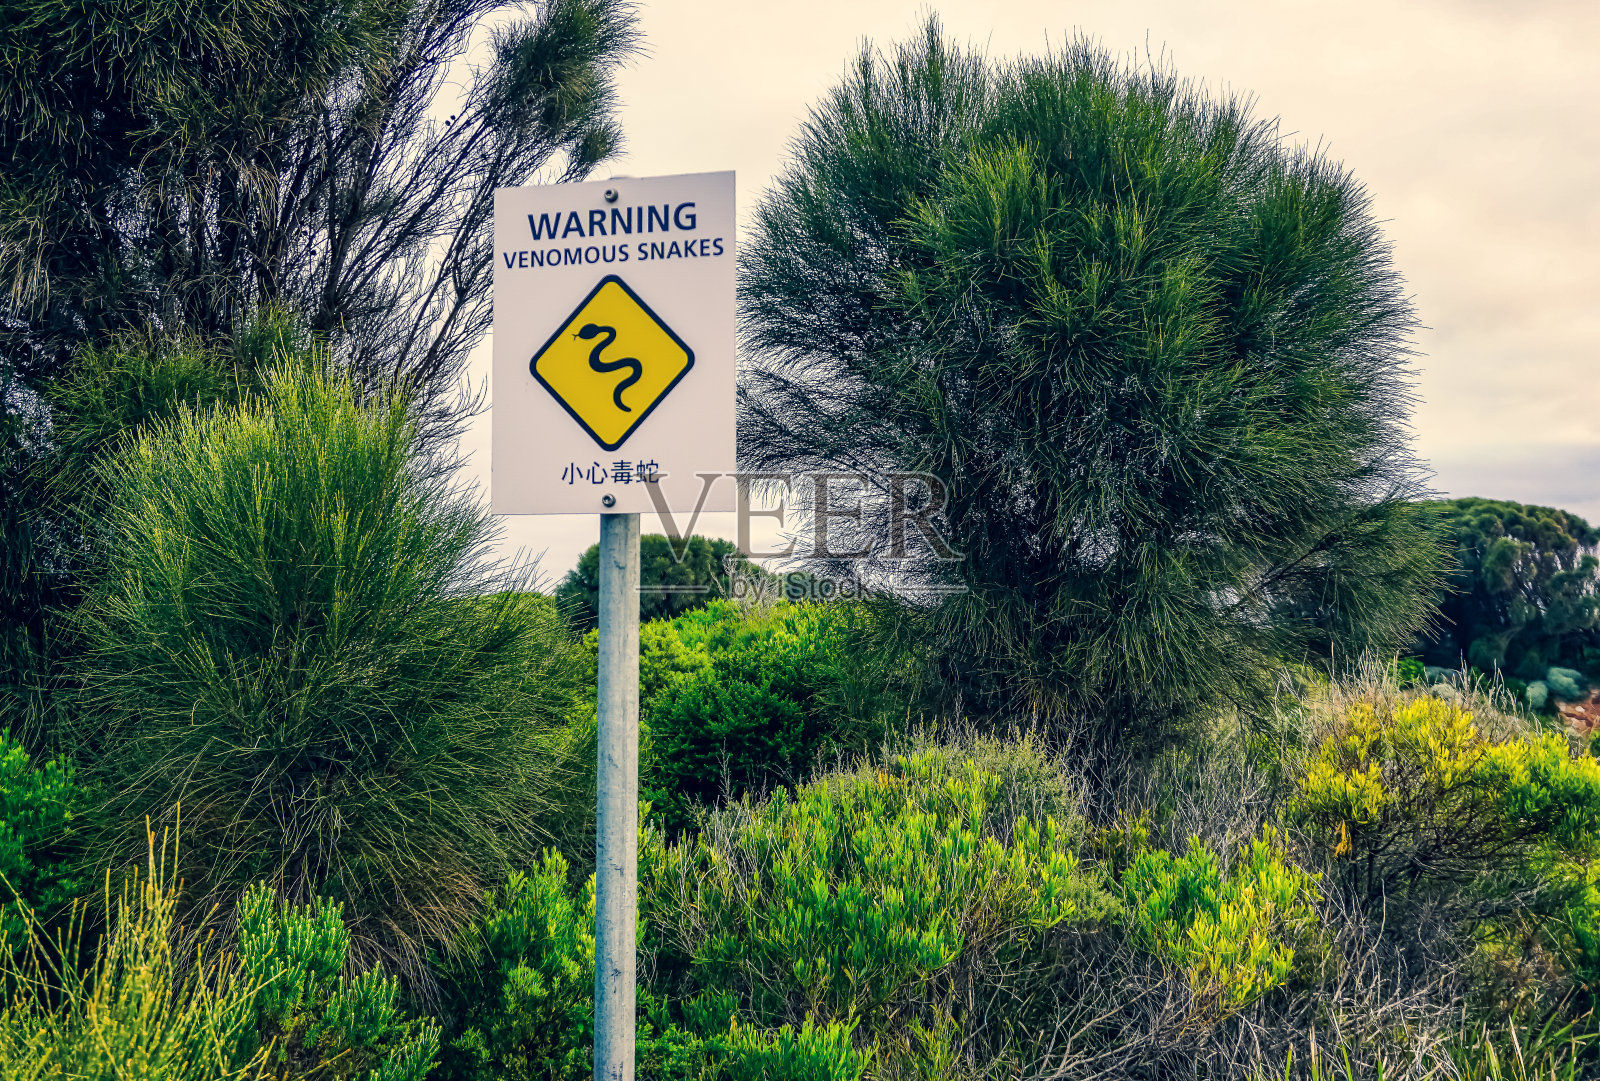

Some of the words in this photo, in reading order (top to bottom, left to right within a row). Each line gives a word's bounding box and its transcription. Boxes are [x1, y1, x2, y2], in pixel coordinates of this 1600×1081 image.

[527, 202, 698, 241] WARNING
[503, 243, 630, 269] VENOMOUS
[637, 237, 725, 261] SNAKES
[561, 459, 660, 486] 小心毒蛇
